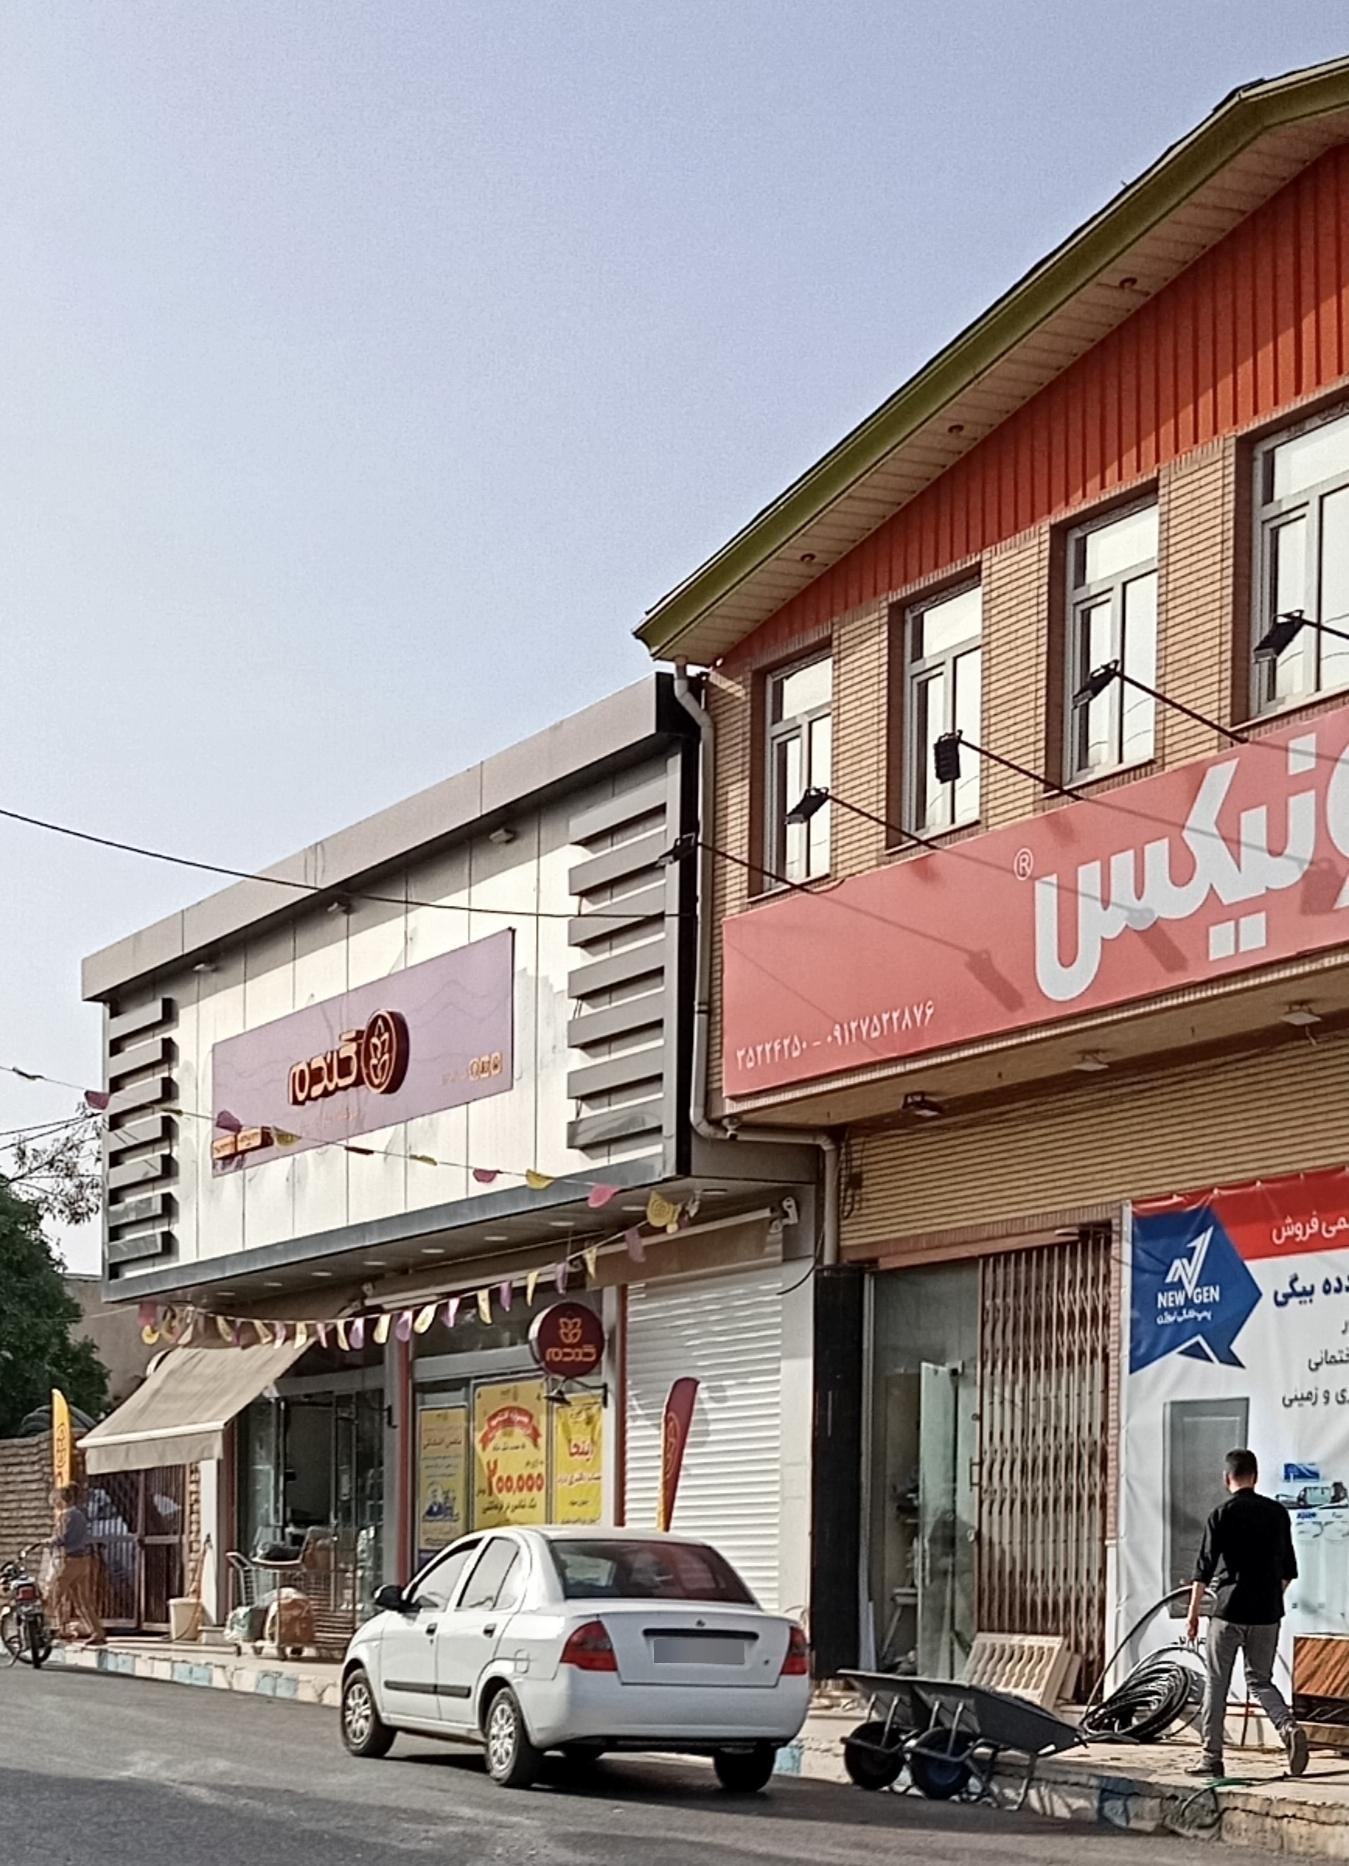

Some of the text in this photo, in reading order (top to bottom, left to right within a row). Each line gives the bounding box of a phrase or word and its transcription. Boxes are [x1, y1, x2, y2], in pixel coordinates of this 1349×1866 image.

[288, 1029, 360, 1105] گندم
[1272, 1210, 1319, 1245] فروش
[1157, 1284, 1220, 1309] NEW GEN
[545, 1343, 598, 1362] گندم
[1282, 1386, 1318, 1408] زمینی
